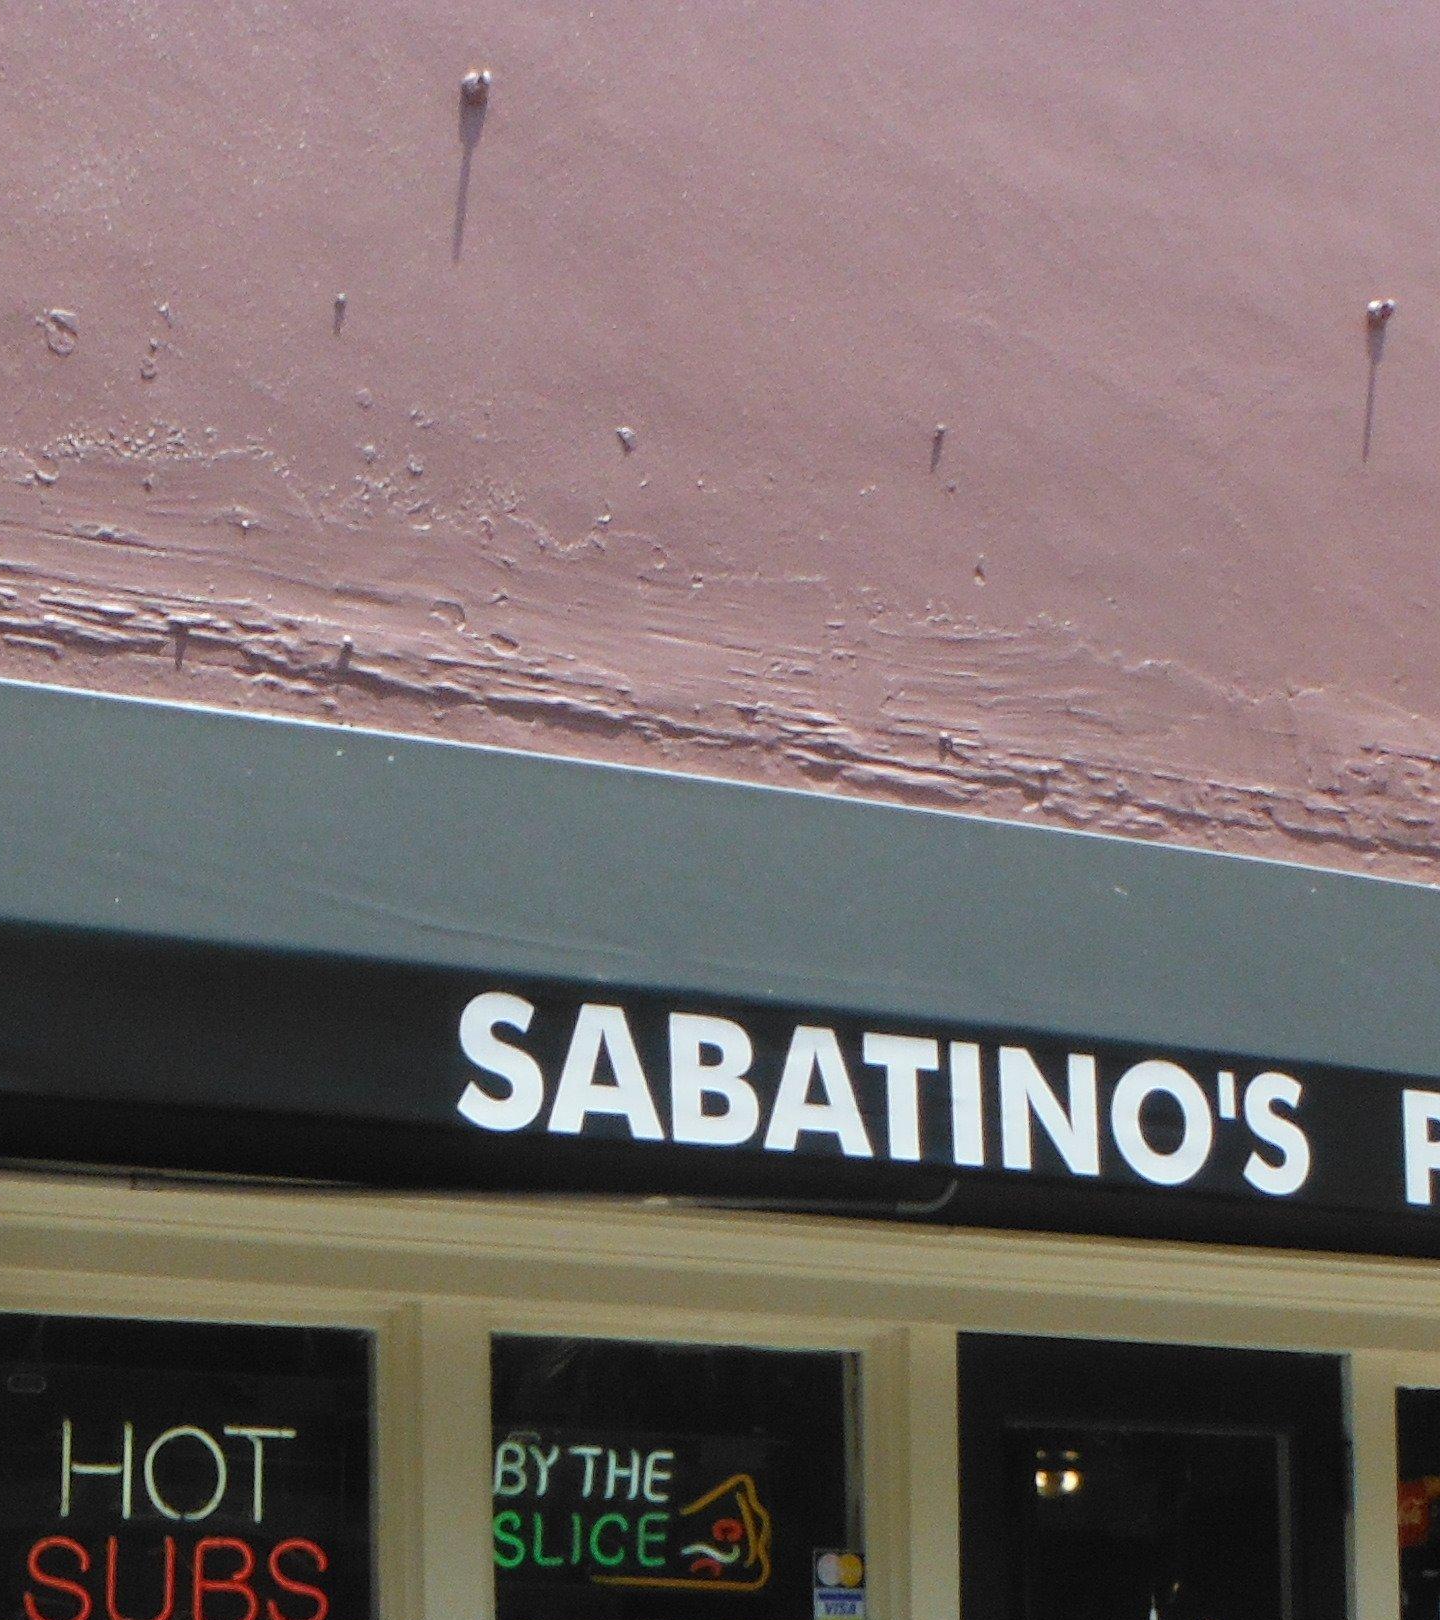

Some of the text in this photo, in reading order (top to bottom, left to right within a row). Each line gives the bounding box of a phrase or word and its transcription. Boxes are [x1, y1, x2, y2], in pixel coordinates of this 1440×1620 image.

[456, 991, 1312, 1196] SABATINO'S
[60, 1419, 298, 1523] HOT
[492, 1441, 675, 1503] BY THE
[493, 1510, 671, 1569] SLICE
